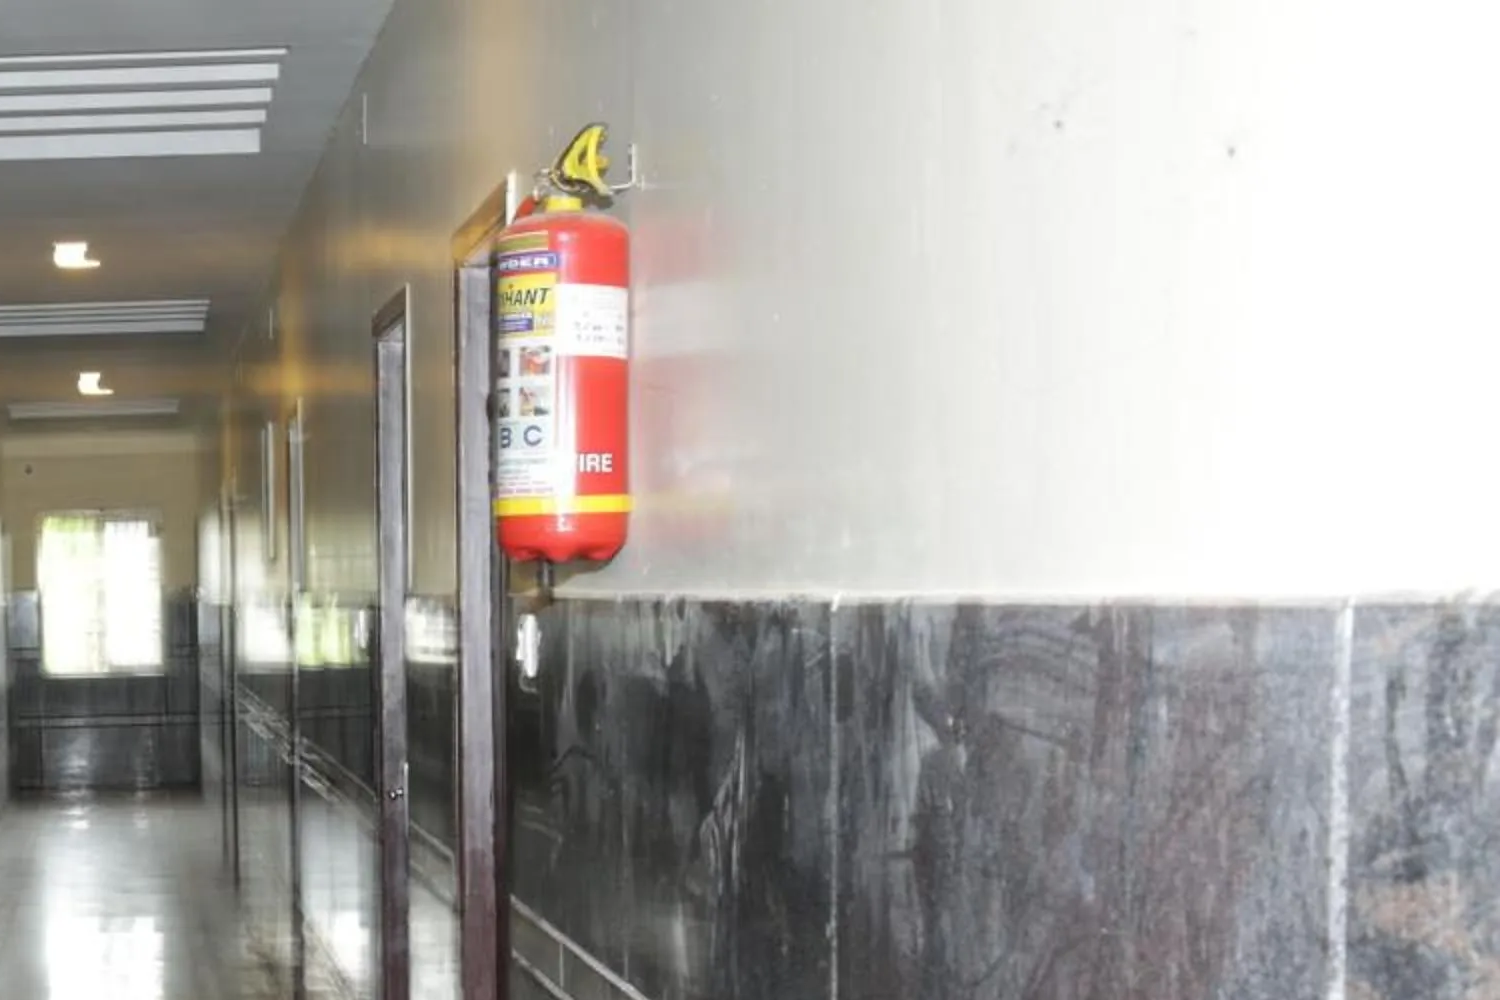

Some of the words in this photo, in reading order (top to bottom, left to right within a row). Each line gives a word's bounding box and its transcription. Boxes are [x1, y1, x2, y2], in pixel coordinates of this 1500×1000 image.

[500, 427, 512, 448] B
[523, 424, 543, 446] C
[578, 452, 613, 473] IRE
